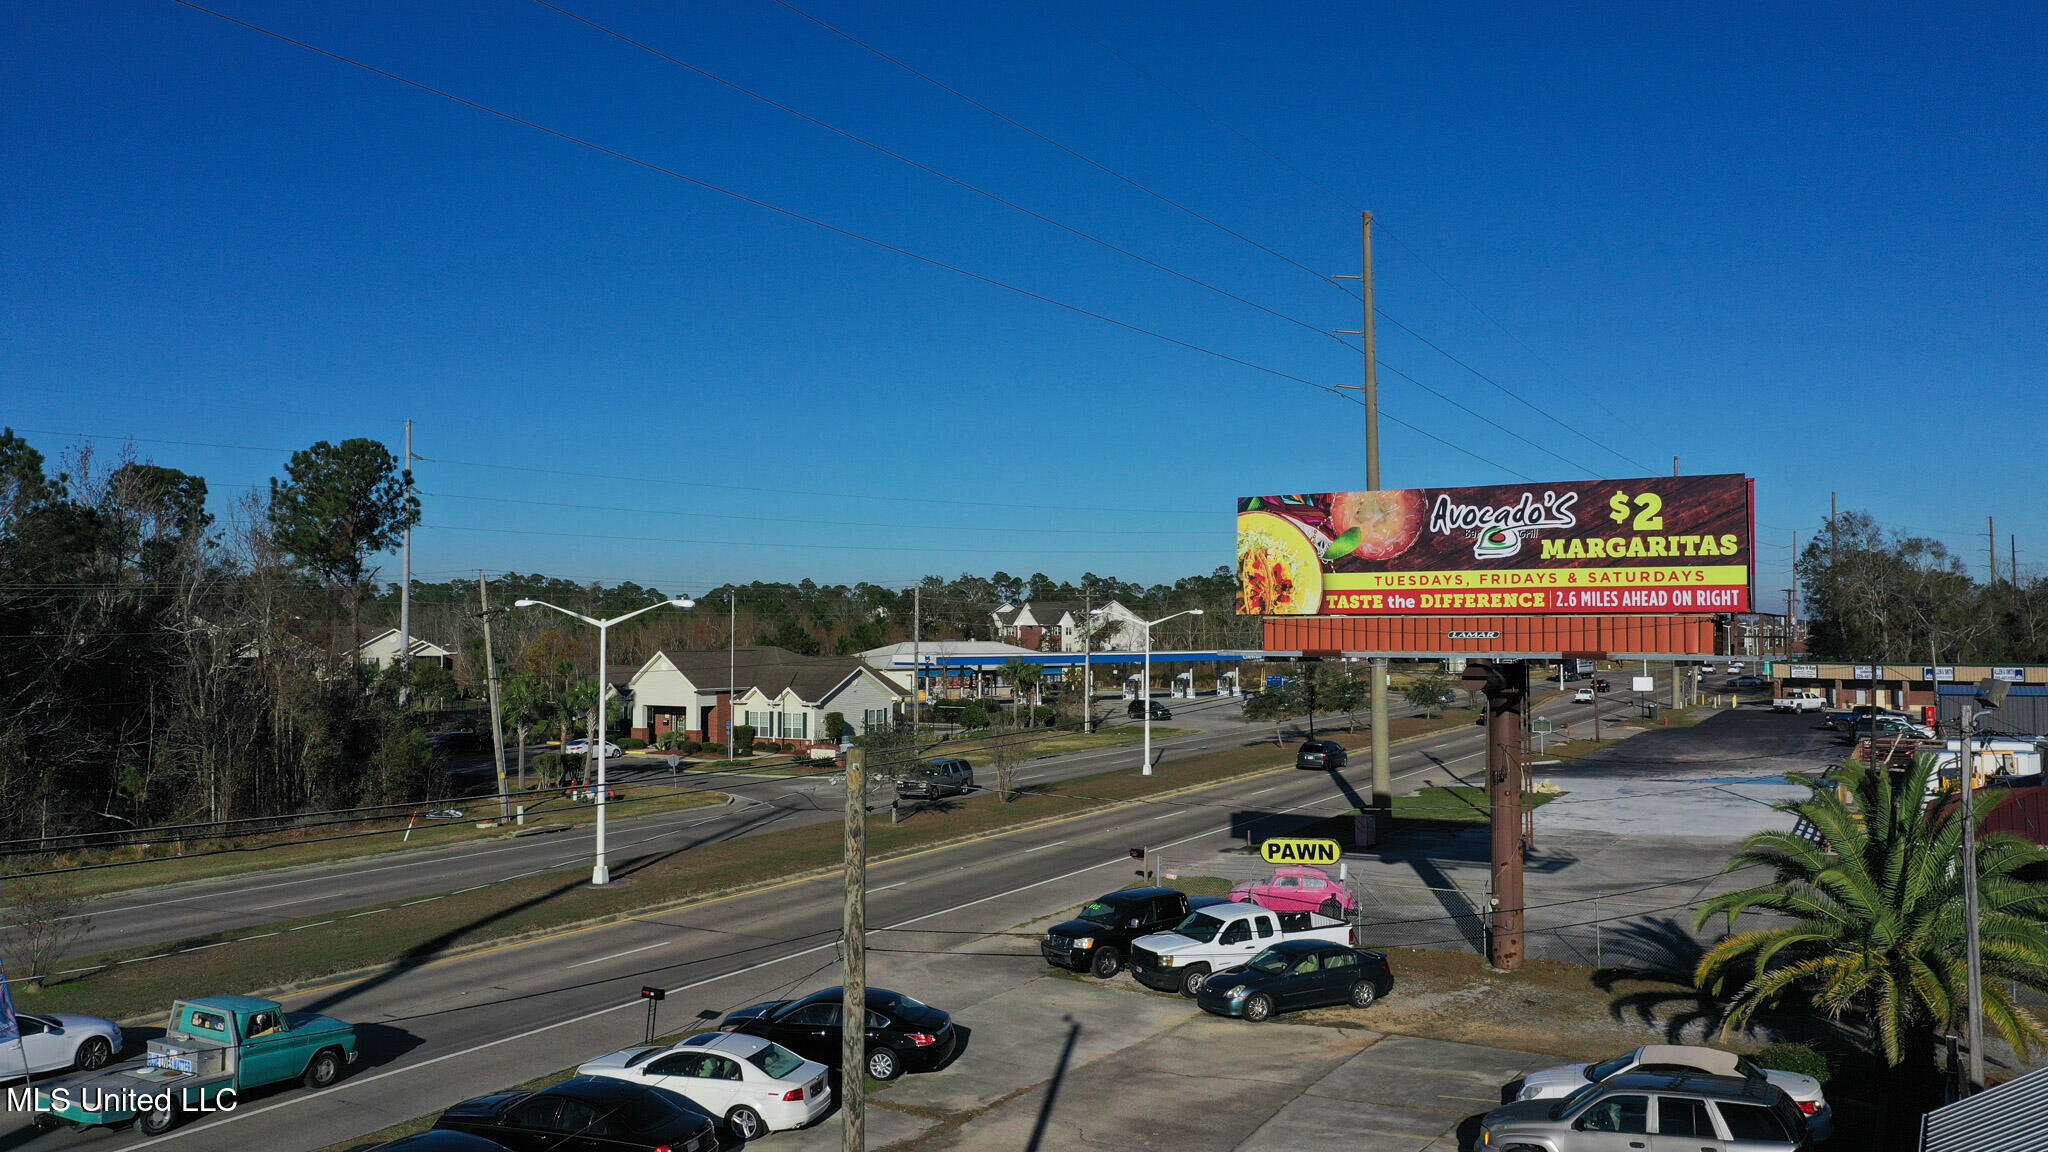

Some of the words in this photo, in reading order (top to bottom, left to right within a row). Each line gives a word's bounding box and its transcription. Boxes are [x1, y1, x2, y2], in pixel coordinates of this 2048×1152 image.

[1609, 490, 1664, 531] $2
[1519, 529, 1539, 539] Grill
[1540, 534, 1739, 560] MARGARITAS
[1374, 574, 1471, 587] TUESDAYS,
[1479, 572, 1558, 585] FRIDAYS
[1567, 572, 1578, 584] &
[1588, 570, 1706, 583] SATURDAYS
[1326, 594, 1384, 609] TASTE
[1387, 595, 1416, 609] the
[1420, 592, 1545, 609] DIFFERENCE
[1556, 591, 1577, 607] 2.6
[1581, 591, 1619, 607] MILES
[1622, 590, 1668, 607] AHEAD
[1672, 590, 1693, 606] ON
[1697, 589, 1740, 606] RIGHT
[1450, 631, 1497, 639] LAMAR
[1267, 843, 1334, 861] PAWN
